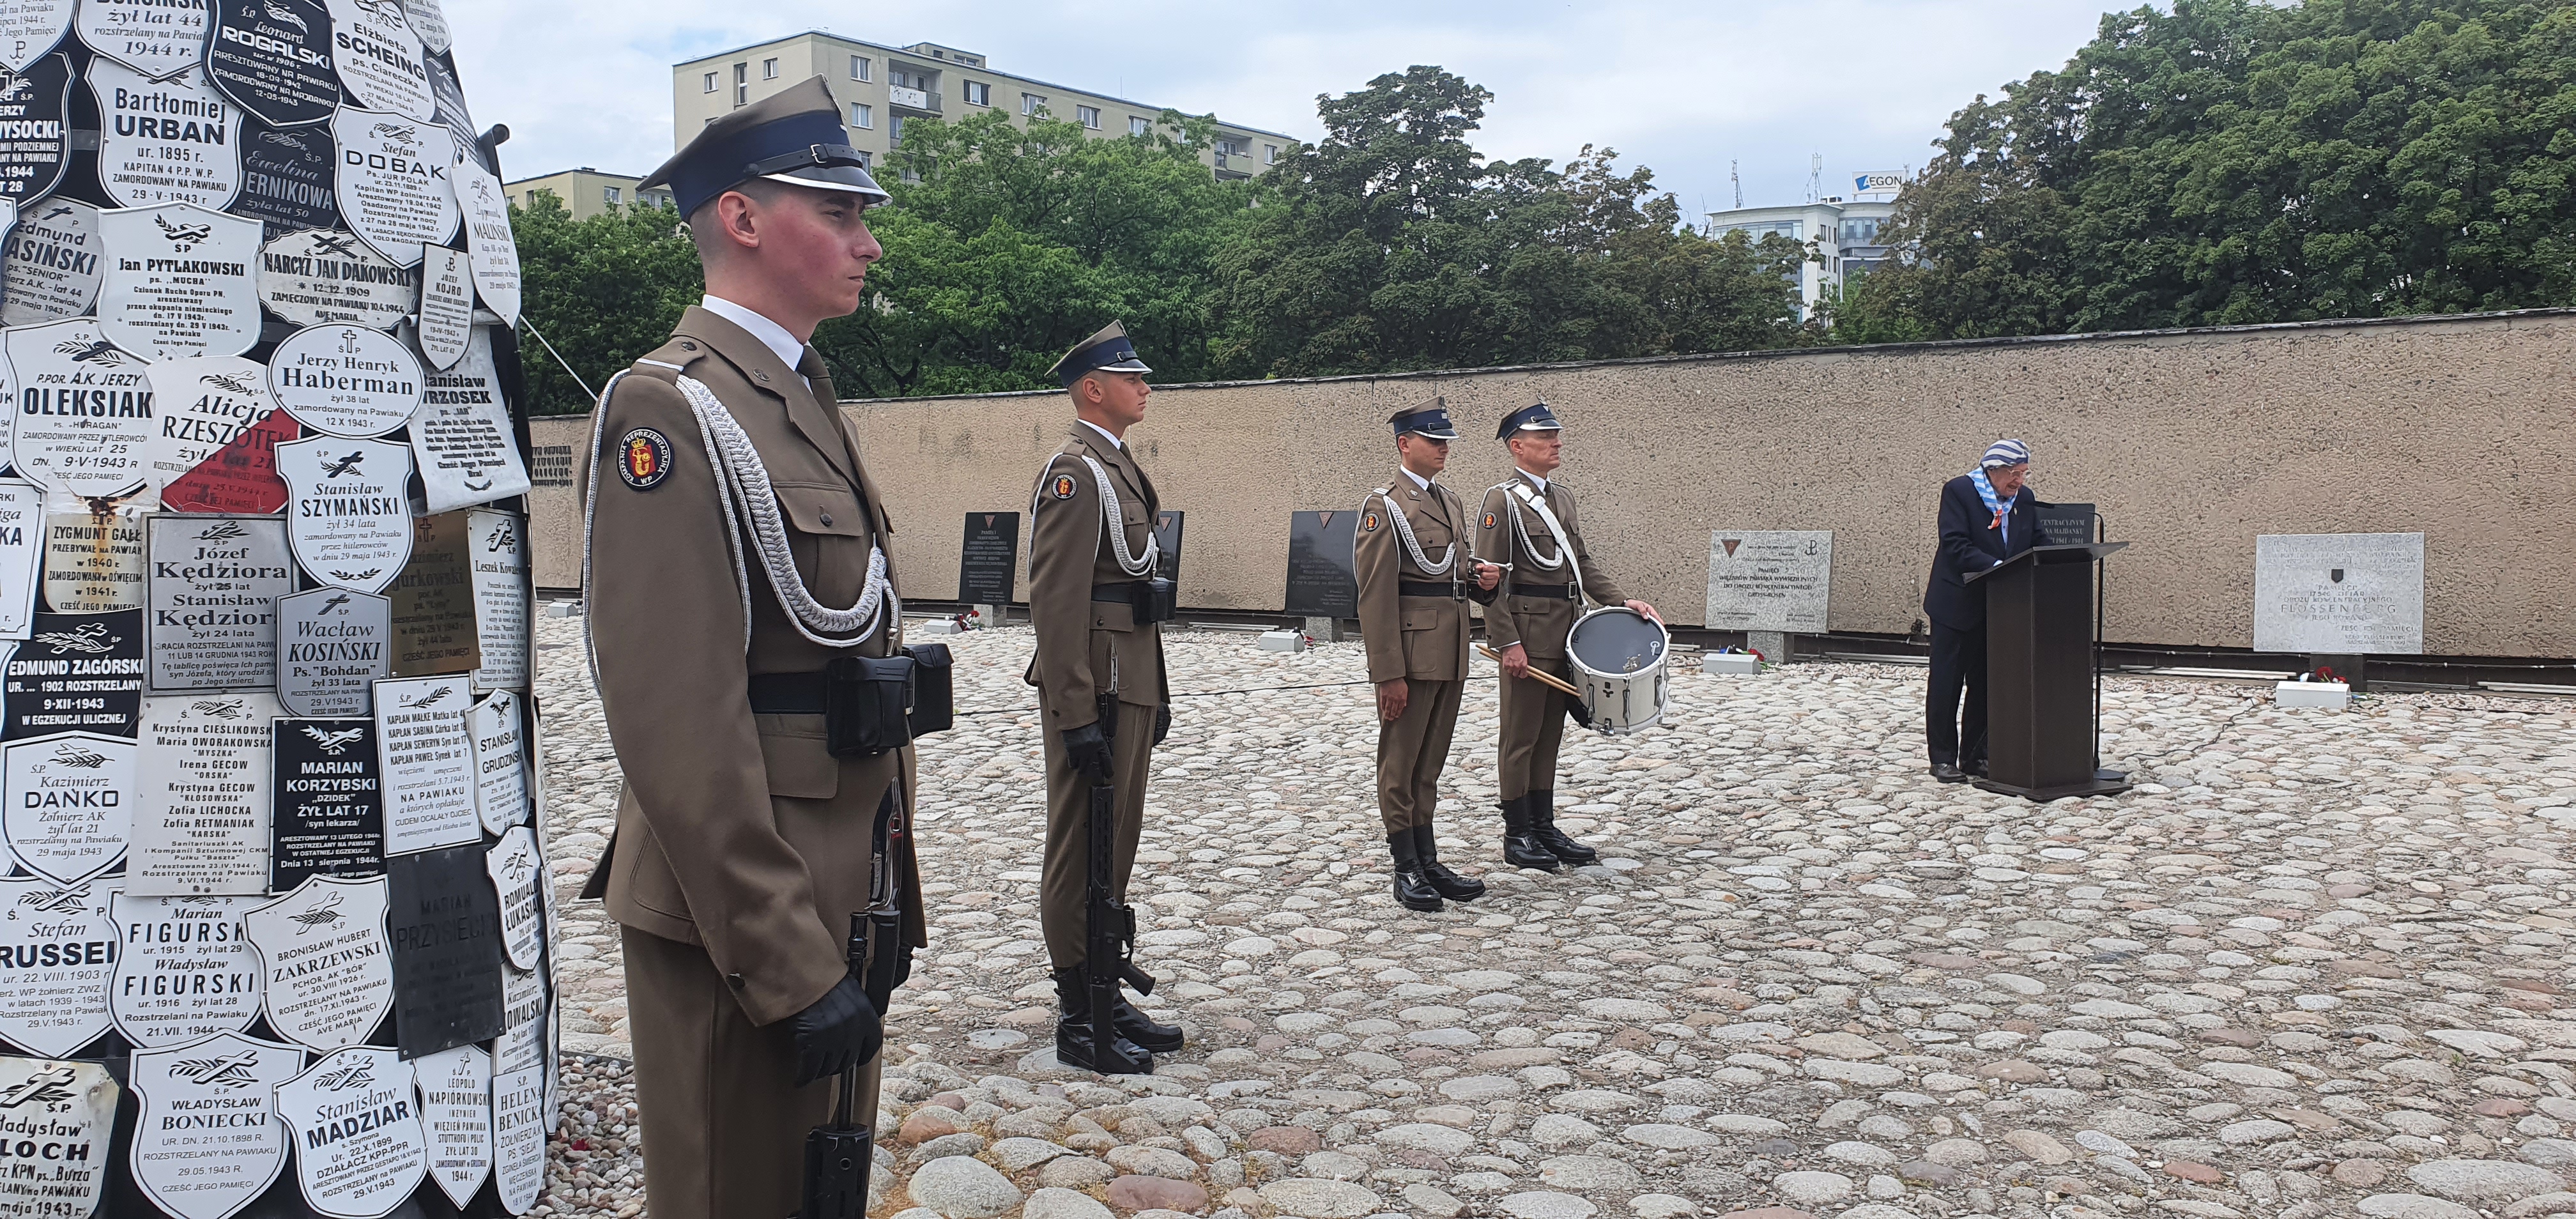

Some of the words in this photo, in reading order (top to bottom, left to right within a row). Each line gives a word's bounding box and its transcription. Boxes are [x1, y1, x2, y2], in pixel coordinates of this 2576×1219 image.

[107, 10, 139, 26] żył
[145, 11, 171, 24] lat
[179, 13, 202, 27] 44
[4, 27, 22, 37] Jego
[25, 26, 56, 36] Pamięci
[254, 20, 304, 45] Leonard
[354, 22, 408, 55] Elżbieta
[123, 42, 172, 56] 1944
[221, 25, 330, 70] ROGALSKI
[336, 32, 426, 82] SCHEING
[213, 50, 279, 75] ARESZTOWANY
[282, 67, 294, 79] NA
[297, 71, 338, 91] PAWIAKU
[351, 57, 369, 72] ps.
[371, 62, 419, 90] Ciareczka
[115, 88, 226, 123] Bartłomiej
[255, 89, 298, 107] 12-05-1943
[115, 114, 225, 145] URBAN
[137, 147, 154, 158] ur.
[159, 146, 189, 162] 1895
[381, 142, 417, 158] Stefan
[123, 162, 164, 174] KAPITAN
[167, 165, 173, 175] 4
[176, 166, 193, 176] P.P.
[196, 169, 215, 178] W.P.
[245, 151, 318, 182] Ewelina
[346, 150, 447, 181] DOBAK
[383, 172, 398, 182] JUR
[401, 175, 429, 186] POLAK
[1863, 176, 1901, 187] AEGON
[119, 257, 141, 272] Jan
[147, 258, 245, 277] PYTLAKOWSKI
[316, 259, 339, 279] JAN
[436, 284, 462, 296] KOJRO
[271, 291, 320, 305] ZAMĘCZONY
[321, 297, 332, 306] NA
[334, 298, 369, 310] PAWIAKU
[297, 352, 339, 369] Jerzy
[344, 356, 399, 375] Henryk
[100, 373, 142, 387] JERZY
[282, 367, 414, 395] Haberman
[23, 387, 153, 419] OLEKSIAK
[330, 394, 342, 404] żył
[346, 395, 356, 404] 38
[359, 396, 370, 404] lat
[188, 394, 275, 425] Alicja
[326, 417, 335, 426] 12
[338, 418, 345, 426] X
[348, 418, 367, 428] 1943
[55, 445, 85, 453] WIEKU
[110, 445, 128, 454] 25
[641, 476, 652, 484] WP
[314, 482, 383, 496] Stanisław
[301, 494, 399, 518] SZYMAŃSKI
[326, 519, 341, 529] żył
[342, 519, 355, 528] 34
[358, 519, 376, 528] lata
[53, 526, 107, 540] ZYGMUNT
[194, 548, 250, 560] Józef
[320, 543, 341, 552] przez
[342, 540, 388, 549] hitlerowców
[155, 562, 287, 582] Kędziora
[173, 594, 271, 606] Stanisław
[297, 621, 374, 638] Wacław
[288, 640, 381, 663] KOSIŃSKI
[8, 659, 69, 676] EDMUND
[72, 655, 143, 675] ZAGÓRSKI
[310, 677, 326, 687] żył
[329, 678, 343, 686] 33
[344, 678, 361, 687] lata
[22, 716, 30, 725] W
[32, 714, 81, 725] EGZEKUCJI
[83, 713, 126, 725] ULICZNEJ
[389, 742, 411, 752] KAPŁAN
[441, 738, 451, 748] Syn
[180, 759, 208, 769] Irena
[212, 760, 249, 769] GECOW
[301, 762, 363, 774] MARIAN
[38, 776, 110, 788] Kazimierz
[286, 778, 376, 792] KORZYBSKI
[24, 788, 119, 809] DAŃKO
[401, 793, 415, 802] NA
[419, 786, 464, 800] PAWIAKU
[38, 811, 84, 823] Żołnierz
[86, 811, 105, 821] AK
[169, 805, 195, 815] Zofia
[200, 806, 251, 815] LICHOCKA
[297, 805, 323, 817] ŻYŁ
[326, 806, 348, 816] LAT
[355, 806, 368, 815] 17
[163, 818, 190, 829] Zofia
[194, 818, 255, 829] RETMANIAK
[36, 848, 50, 857] 29
[52, 848, 78, 859] maja
[79, 847, 102, 856] 1943
[318, 857, 350, 868] sierpnia
[355, 857, 380, 866] 1944r.
[505, 877, 538, 911] ROMUALD
[170, 908, 222, 919] Marian
[27, 919, 87, 941] Stefan
[277, 937, 335, 962] BRONISŁAW
[337, 928, 372, 945] HUBERT
[155, 958, 229, 973] Władysław
[273, 940, 381, 984] ZAKRZEWSKI
[124, 972, 254, 997] FIGURSKI
[293, 977, 325, 990] PCHOR.
[327, 974, 339, 983] AK
[155, 999, 180, 1008] 1916
[192, 999, 208, 1008] żył
[210, 997, 223, 1006] lat
[226, 997, 238, 1005] 28
[448, 1078, 475, 1089] LEOPOLD
[171, 1097, 262, 1111] WŁADYSŁAW
[315, 1086, 397, 1124] Stanisław
[429, 1090, 491, 1106] NAPIÓRKOWSKI
[500, 1086, 542, 1111] HELENA
[161, 1112, 268, 1131] BONIECKI
[306, 1100, 410, 1151] MADZIAR
[498, 1108, 544, 1133] BENICKA
[349, 1136, 392, 1156] 22.X.1899
[452, 1170, 468, 1182] 1944
[162, 1181, 192, 1192] CZEŚĆ
[194, 1181, 218, 1191] JEGO
[219, 1181, 254, 1191] PAMIĘCI
